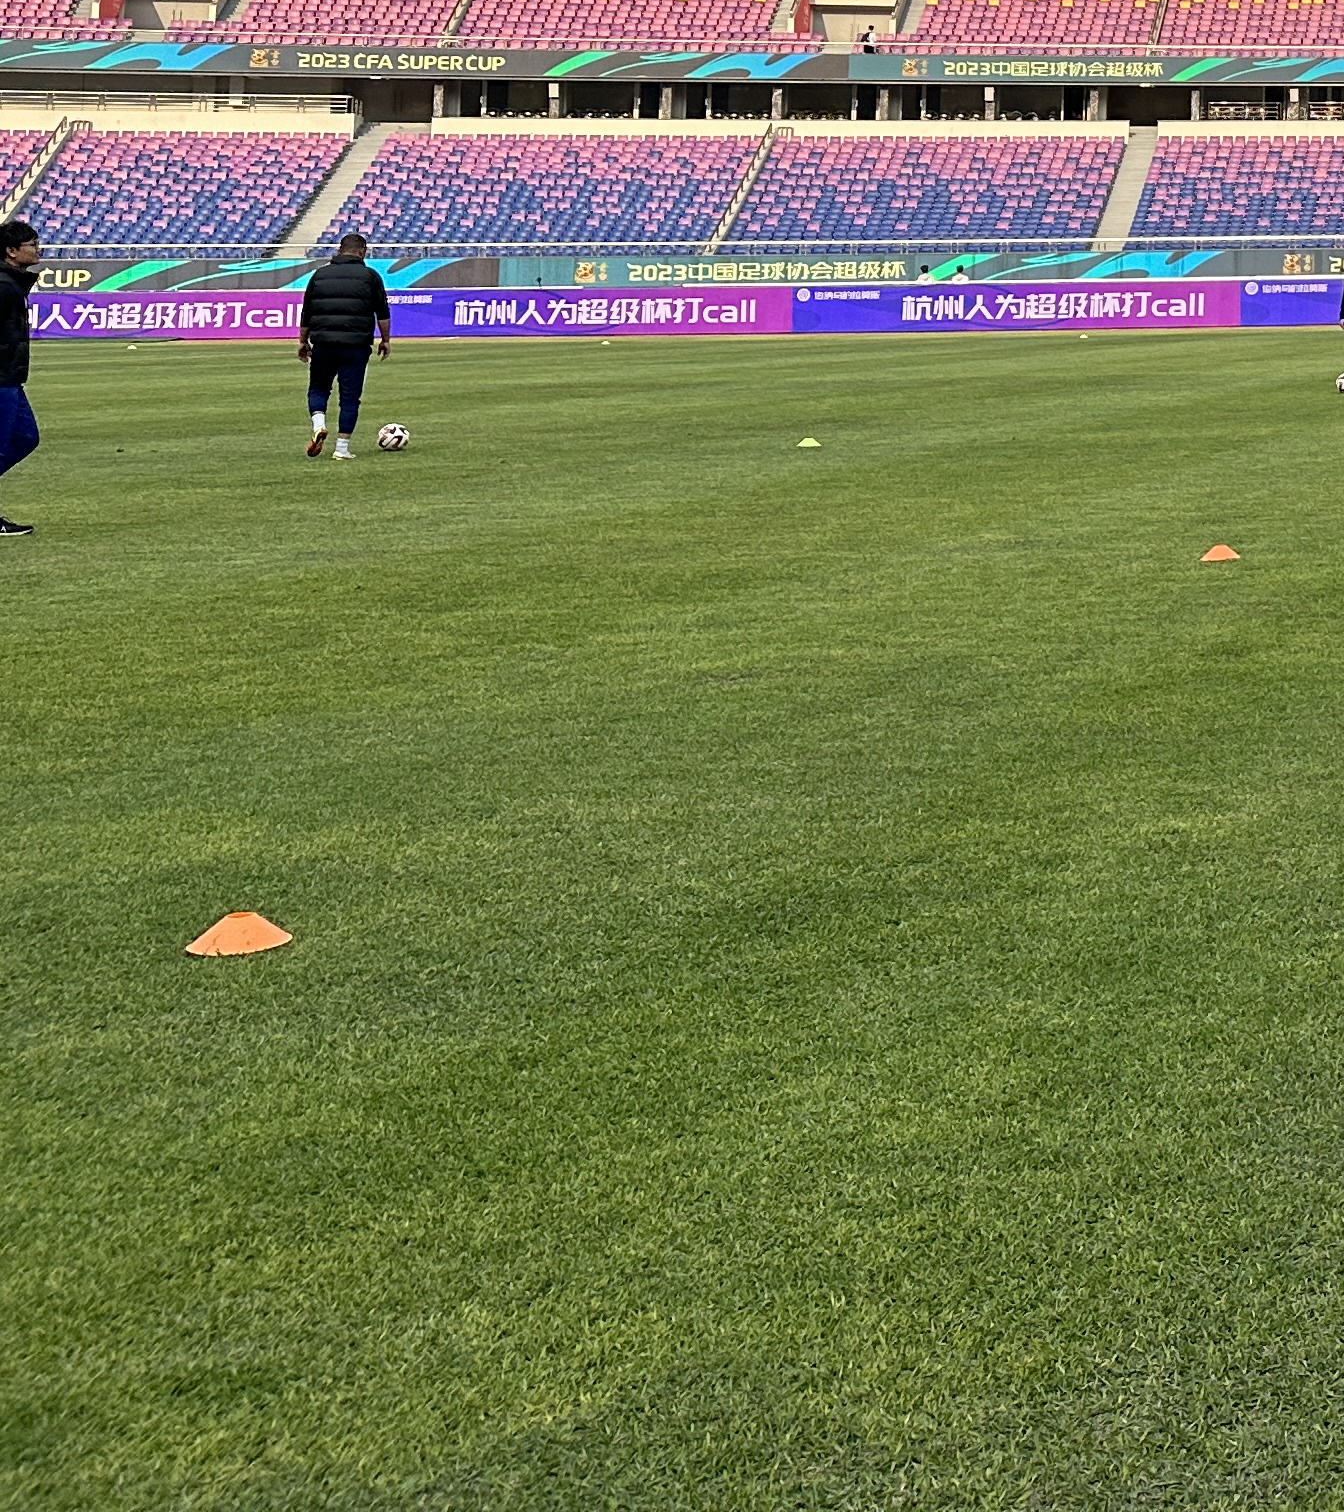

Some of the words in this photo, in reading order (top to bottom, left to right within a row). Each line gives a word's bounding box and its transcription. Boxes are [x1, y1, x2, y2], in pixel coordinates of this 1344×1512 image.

[297, 52, 350, 68] 2023
[353, 53, 393, 69] CFA
[397, 53, 463, 70] SUPER
[465, 54, 506, 71] CUP
[943, 60, 1163, 77] 2023中国足球协会超级杯
[38, 268, 91, 287] CUP
[627, 261, 905, 283] 2023中国足球协会超级杯
[454, 299, 757, 326] 杭州人为超级杯打call
[902, 292, 1205, 321] 杭州人为超级杯打call
